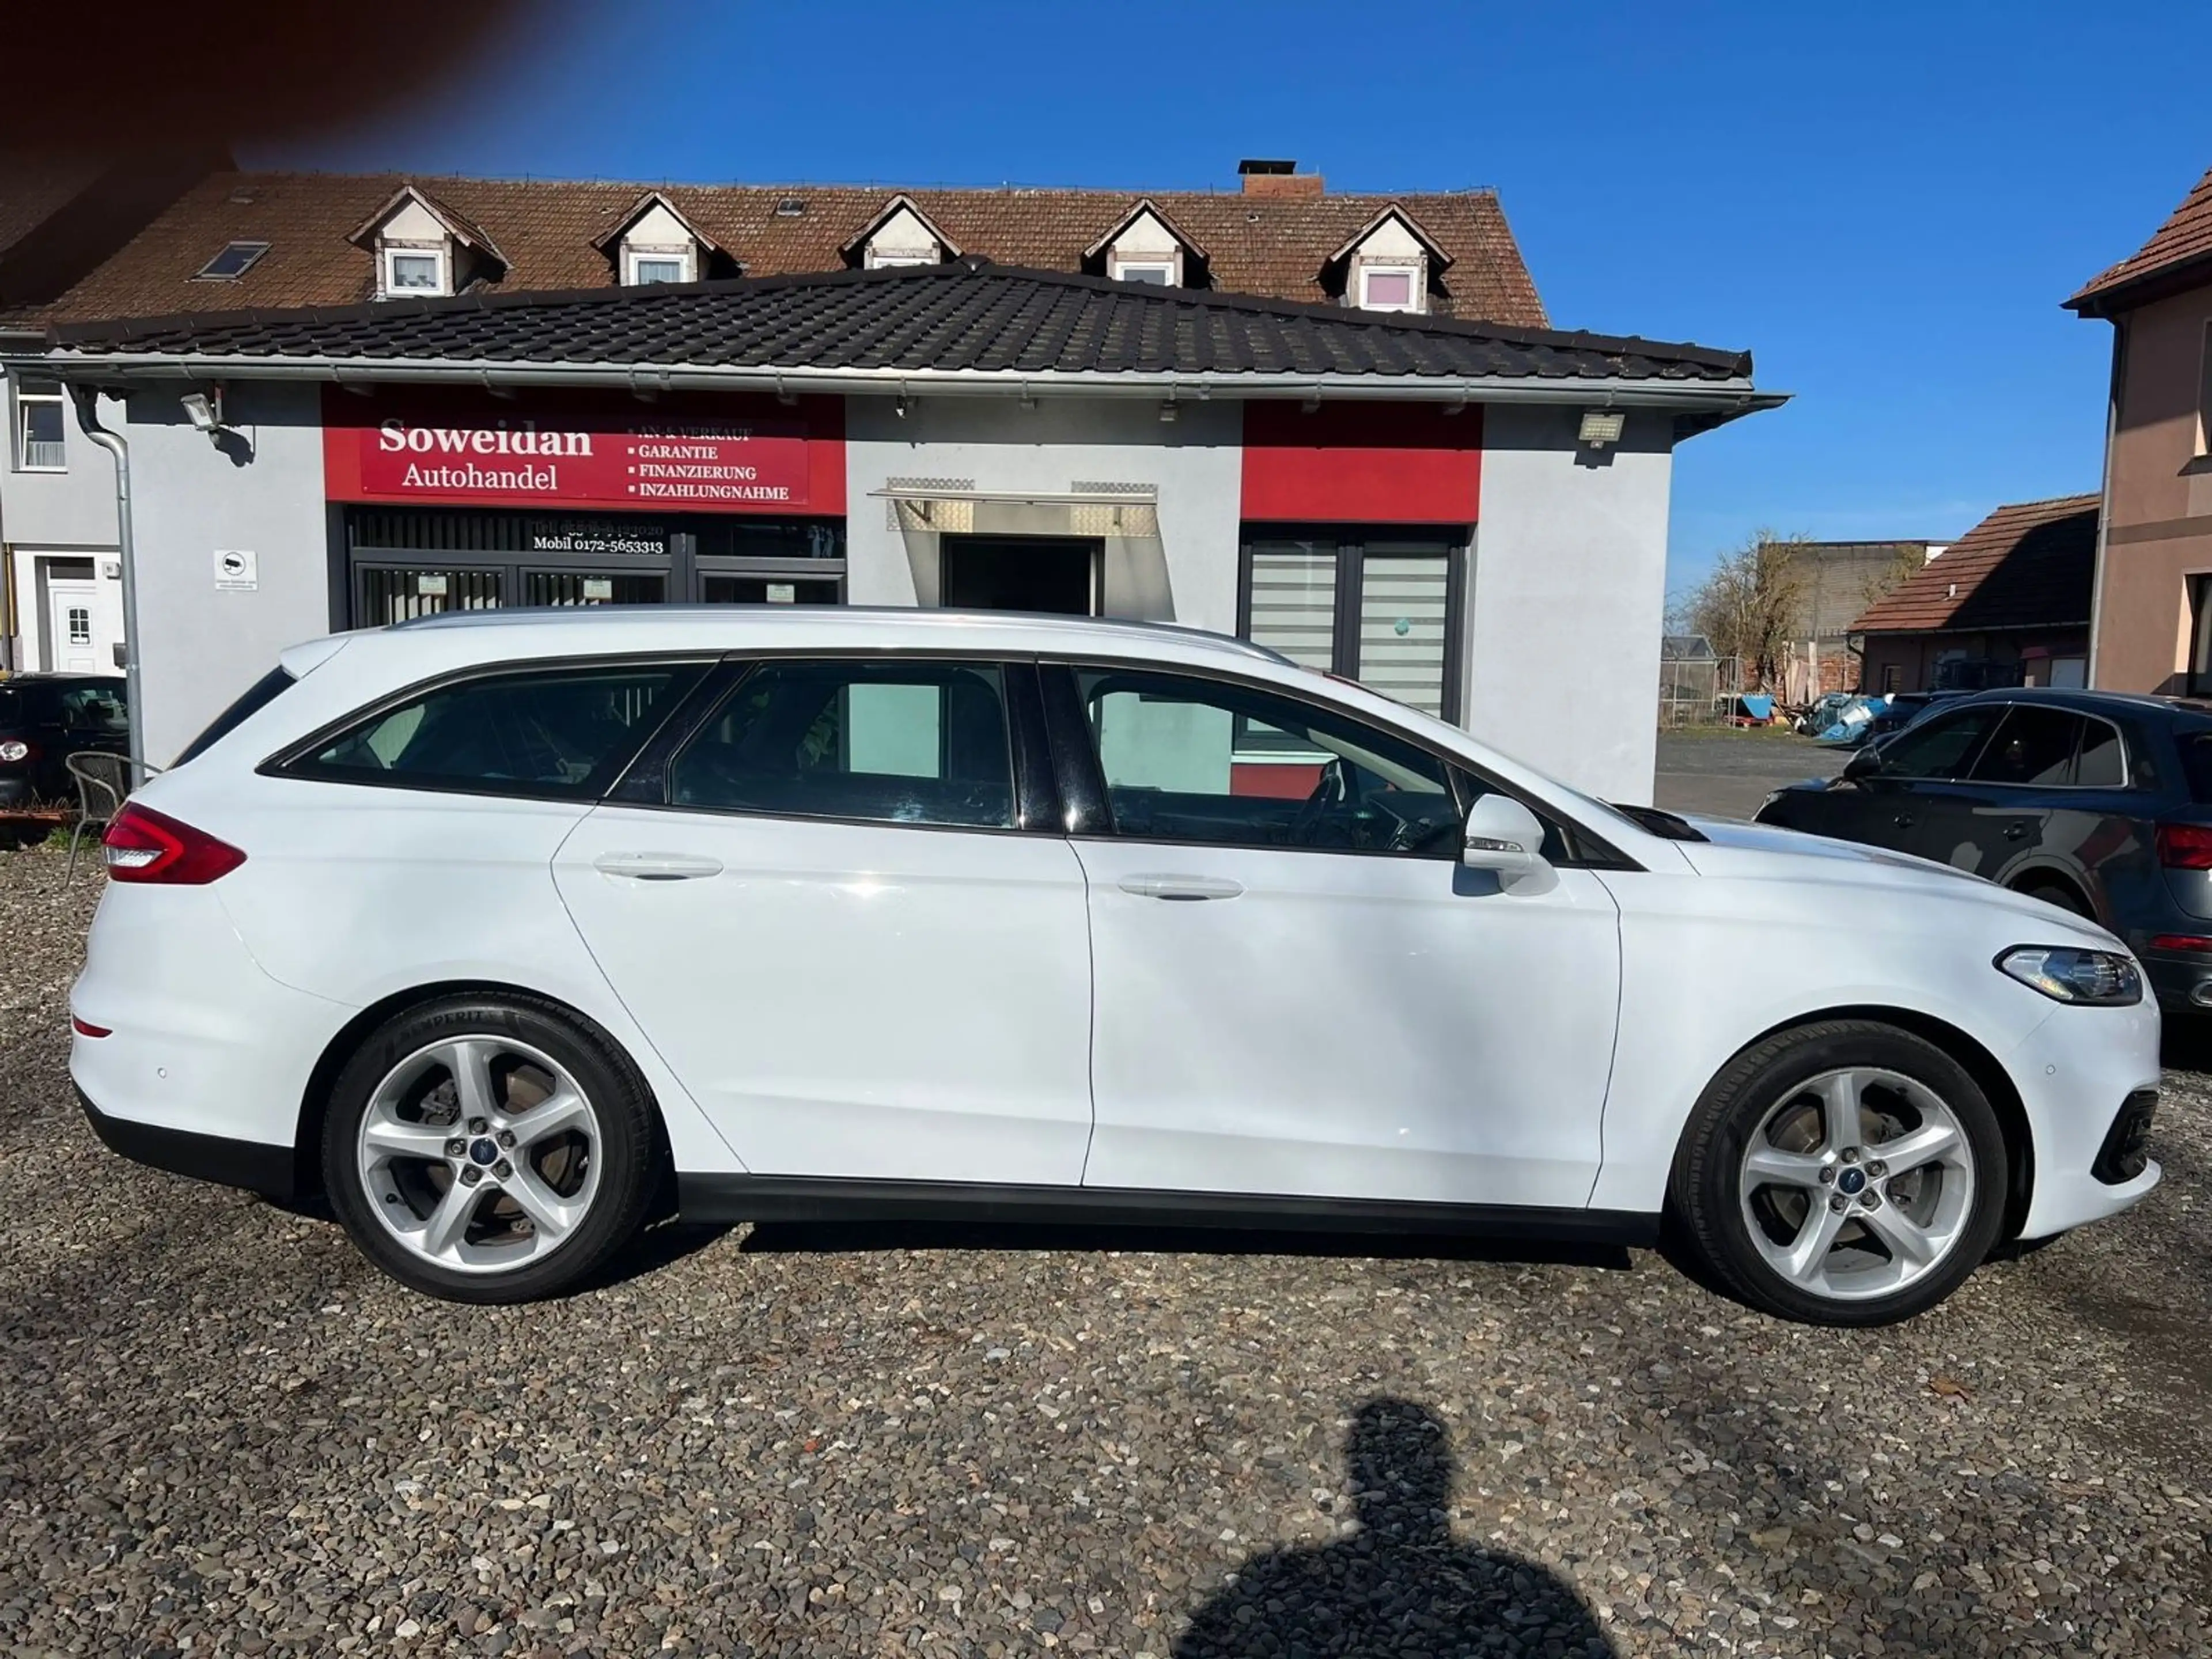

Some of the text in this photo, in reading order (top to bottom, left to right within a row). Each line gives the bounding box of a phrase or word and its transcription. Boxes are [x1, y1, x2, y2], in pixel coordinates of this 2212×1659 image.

[380, 418, 593, 456] Soweidan
[679, 427, 753, 441] VERKAUF
[639, 445, 718, 460] GARANTIE
[402, 463, 557, 490] Autohandel
[639, 464, 756, 480] FINANZIERUNG
[639, 483, 789, 500] INZAHLUNGNAHME
[533, 536, 664, 554] Mobil 0172-5653313
